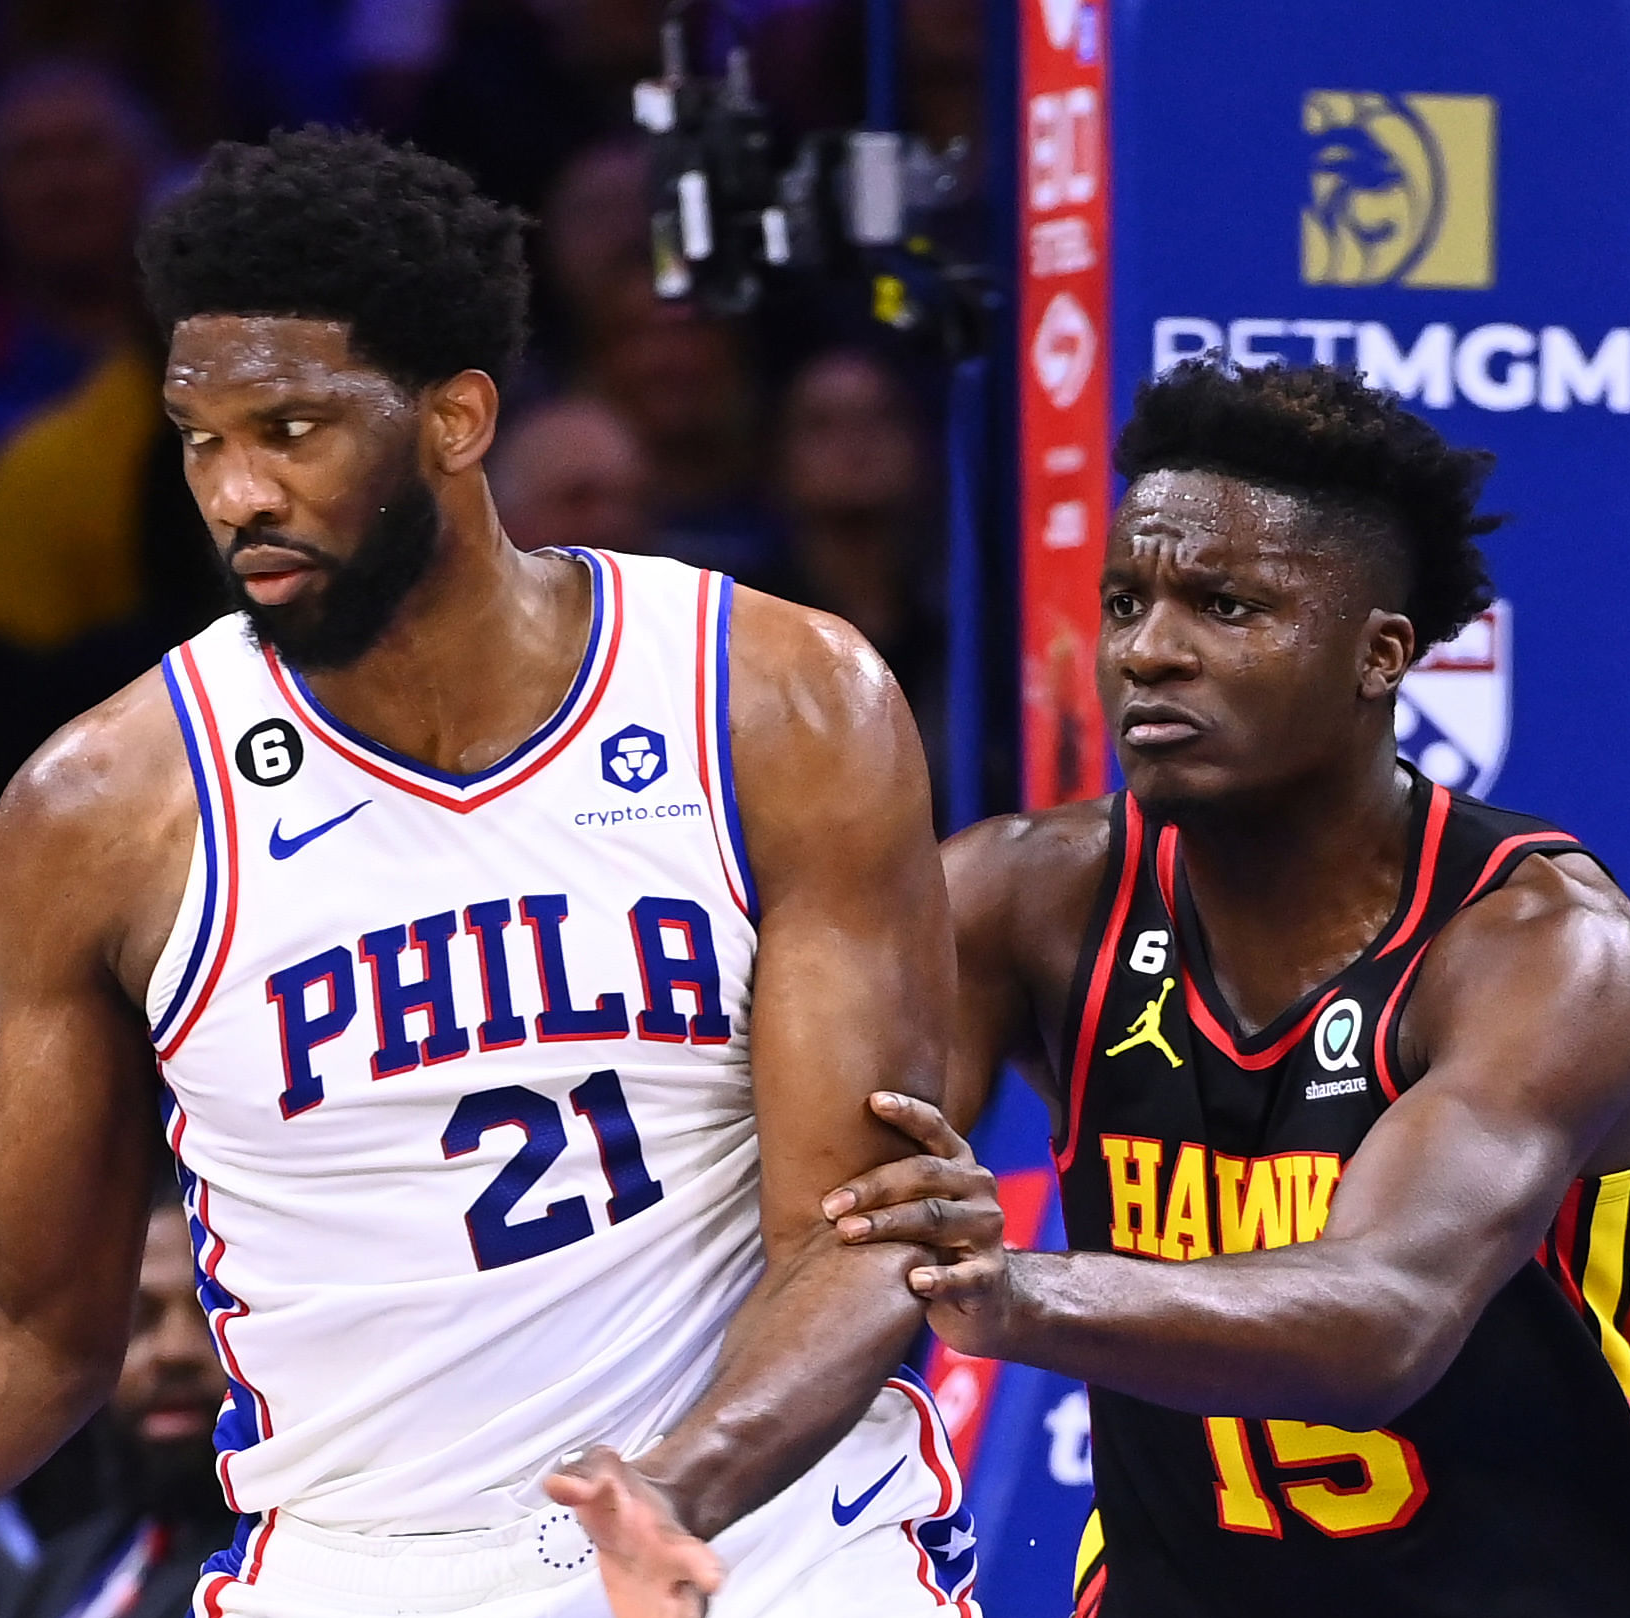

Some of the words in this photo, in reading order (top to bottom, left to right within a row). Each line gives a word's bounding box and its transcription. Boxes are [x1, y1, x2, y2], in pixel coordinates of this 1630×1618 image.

[250, 727, 292, 780] 6
[574, 803, 702, 827] crypto.com
[1128, 929, 1169, 975] 6
[266, 893, 732, 1120] PHILA
[1305, 1076, 1368, 1101] sharecare
[441, 1068, 664, 1272] 21
[1099, 1133, 1343, 1263] HAWK
[1202, 1416, 1430, 1541] 15
